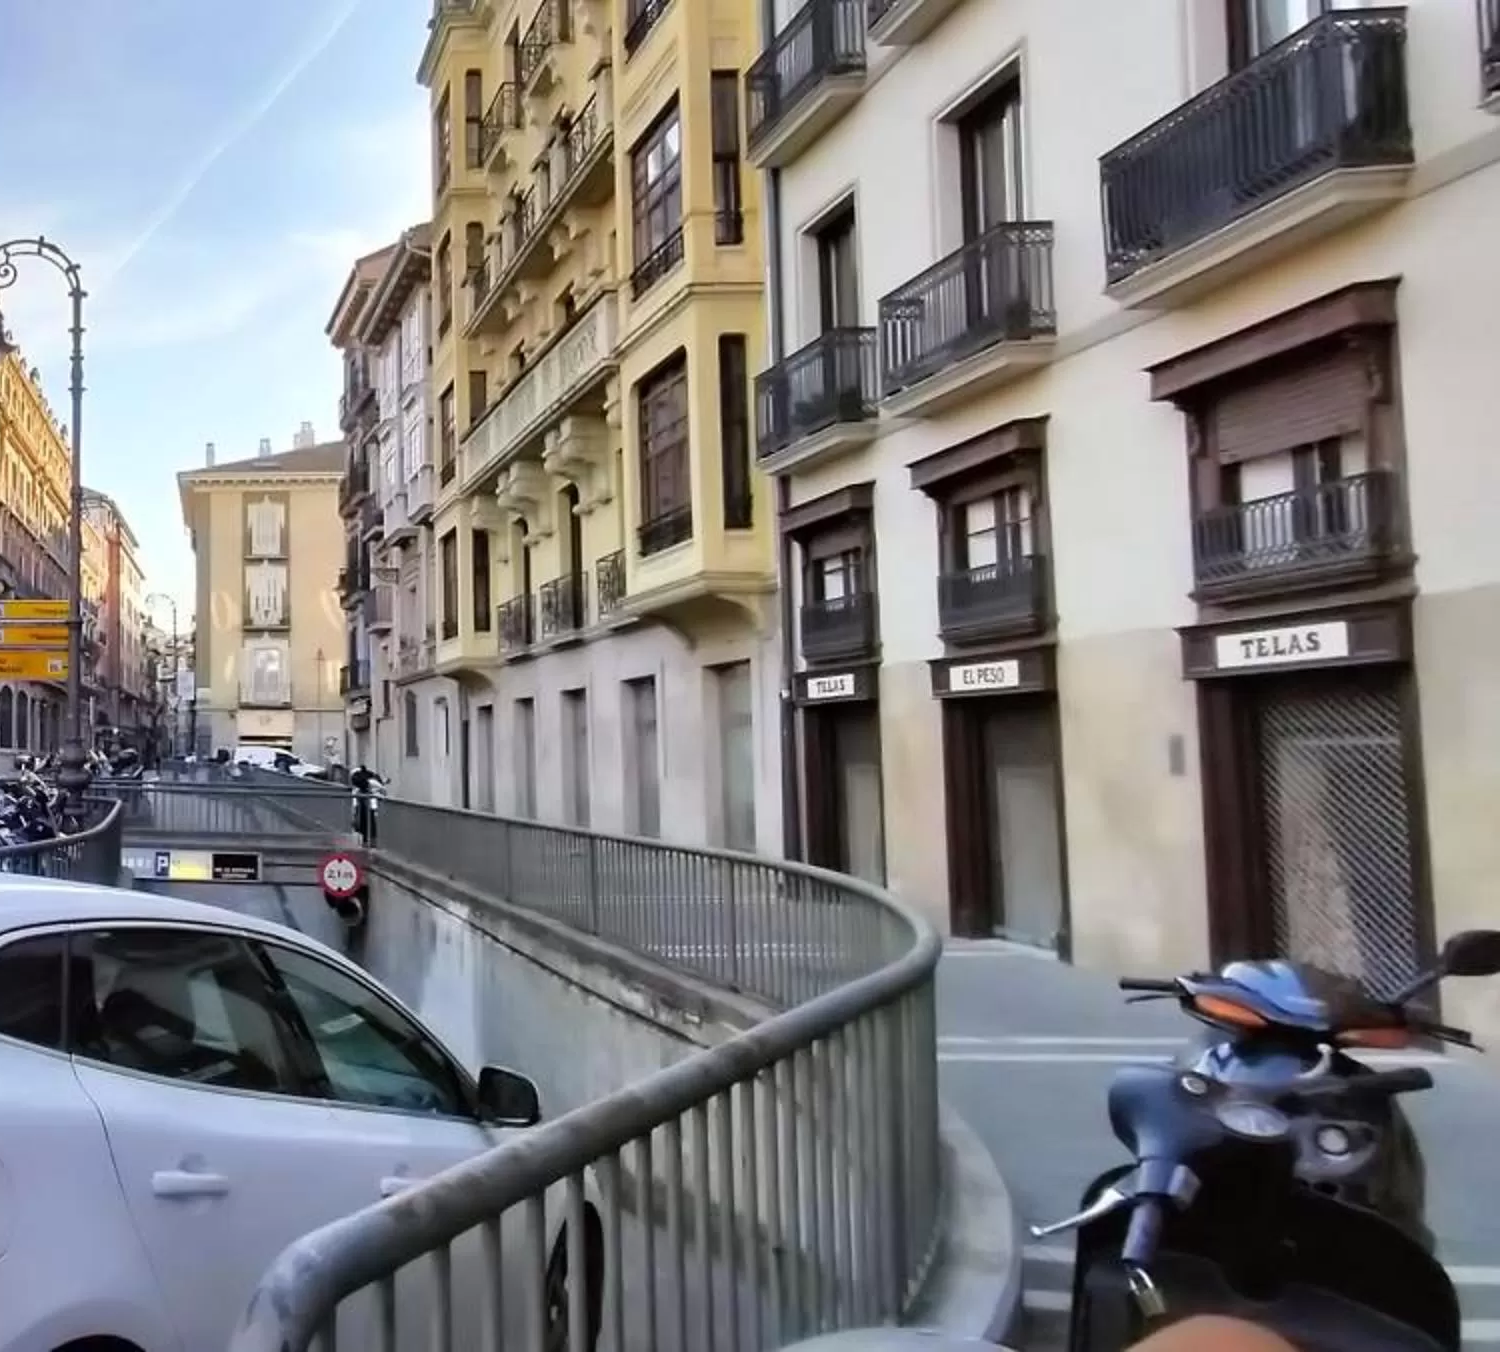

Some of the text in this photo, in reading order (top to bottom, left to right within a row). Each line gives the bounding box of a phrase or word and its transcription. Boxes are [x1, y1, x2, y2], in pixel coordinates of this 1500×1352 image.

[1240, 631, 1321, 659] TELAS
[963, 666, 1005, 685] EL PESO
